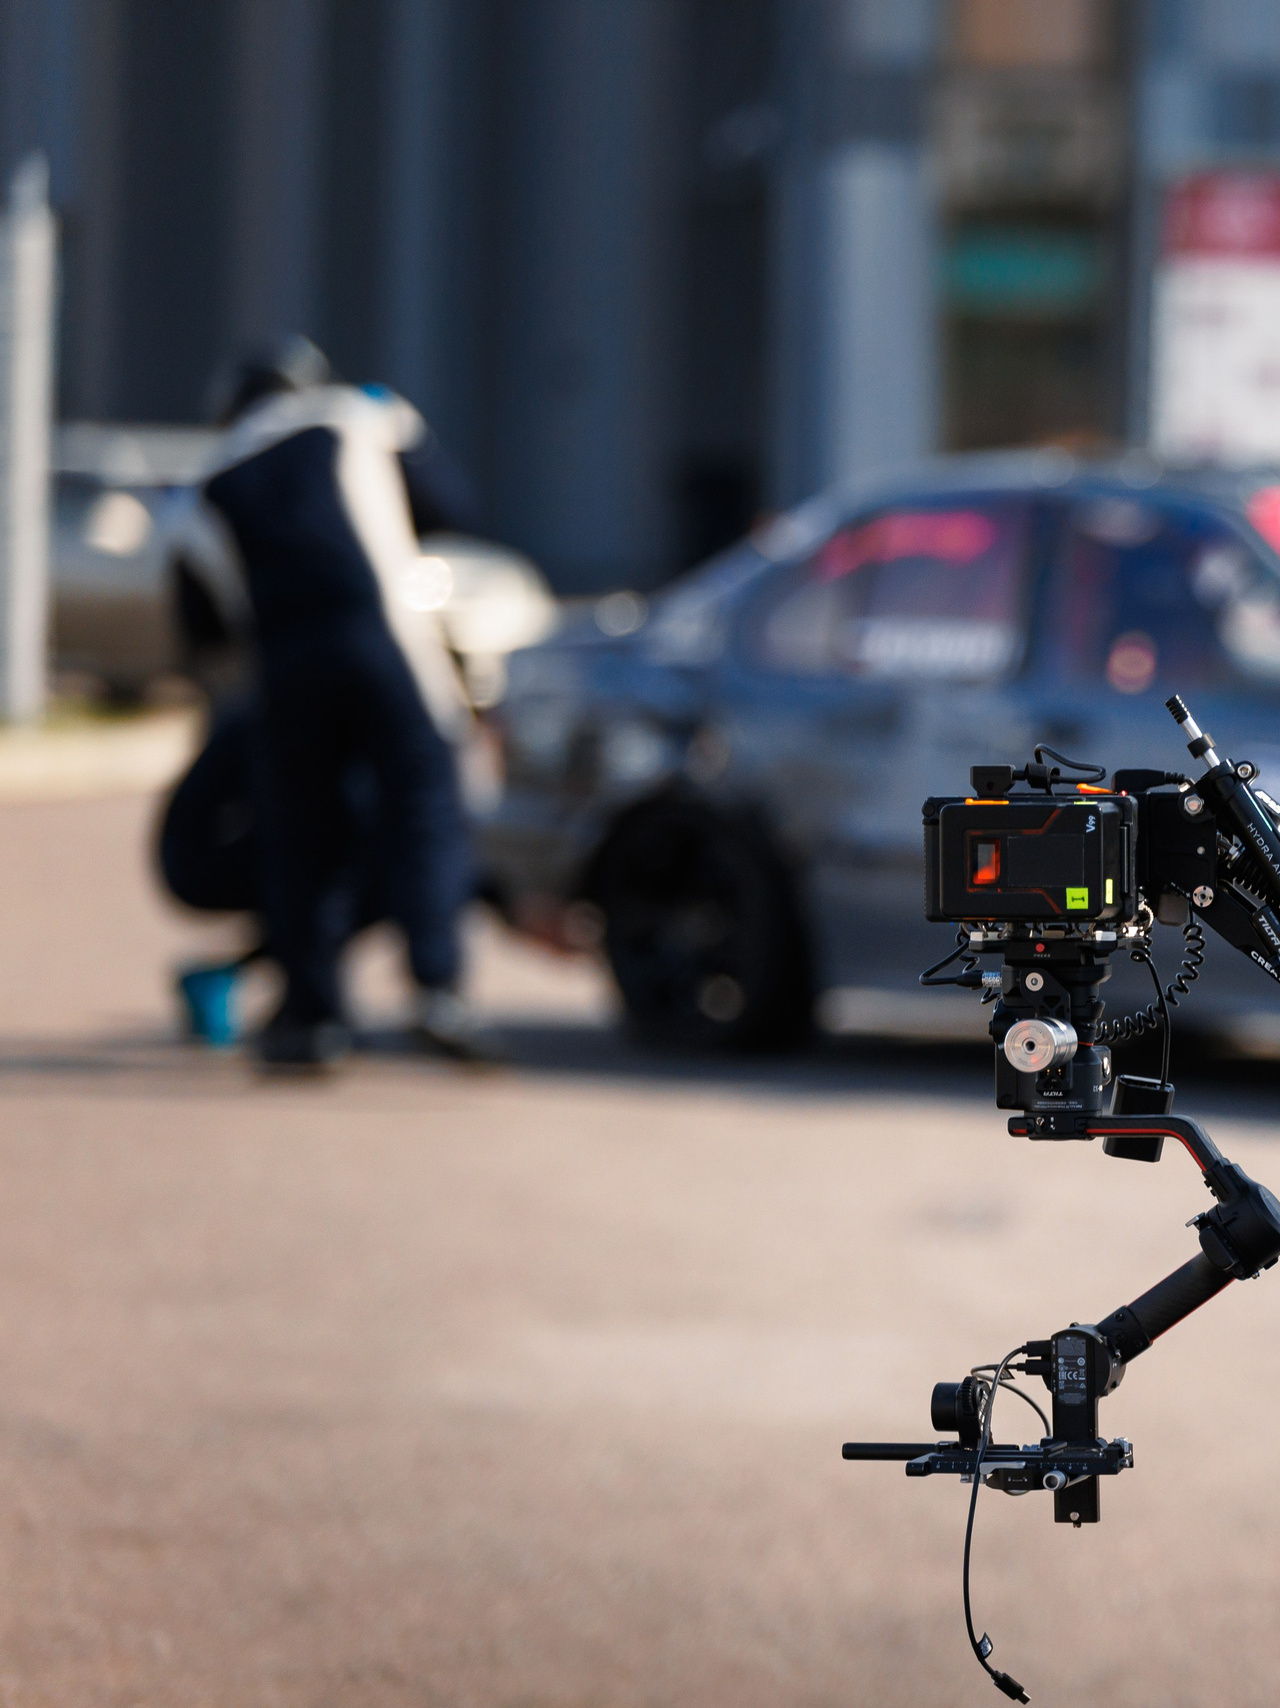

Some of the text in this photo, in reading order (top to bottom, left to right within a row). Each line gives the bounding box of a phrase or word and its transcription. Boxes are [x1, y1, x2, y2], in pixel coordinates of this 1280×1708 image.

[1086, 815, 1096, 833] V99
[1247, 822, 1273, 861] HYDRA
[1258, 914, 1280, 946] TILTA
